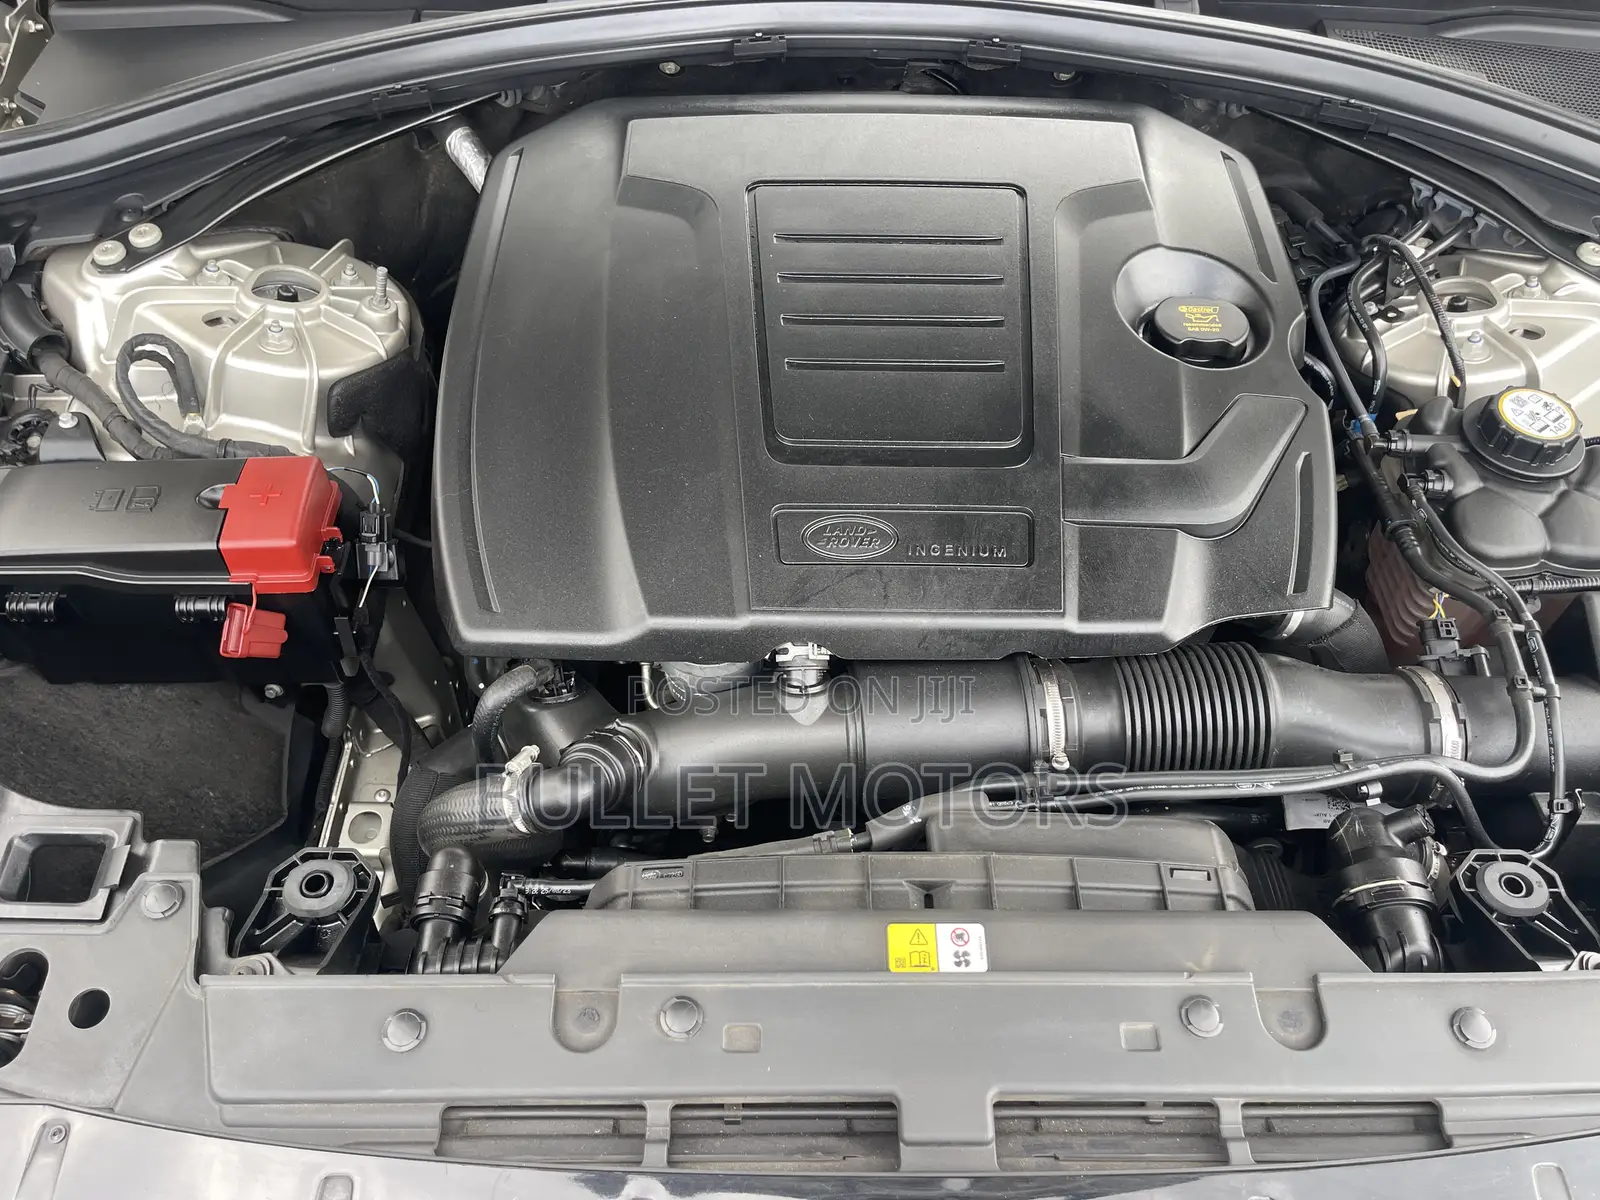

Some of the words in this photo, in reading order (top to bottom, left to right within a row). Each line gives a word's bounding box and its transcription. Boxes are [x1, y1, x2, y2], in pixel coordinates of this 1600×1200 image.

[823, 525, 868, 536] LAND
[826, 537, 881, 549] ROVER
[908, 544, 1007, 558] INGENIUM
